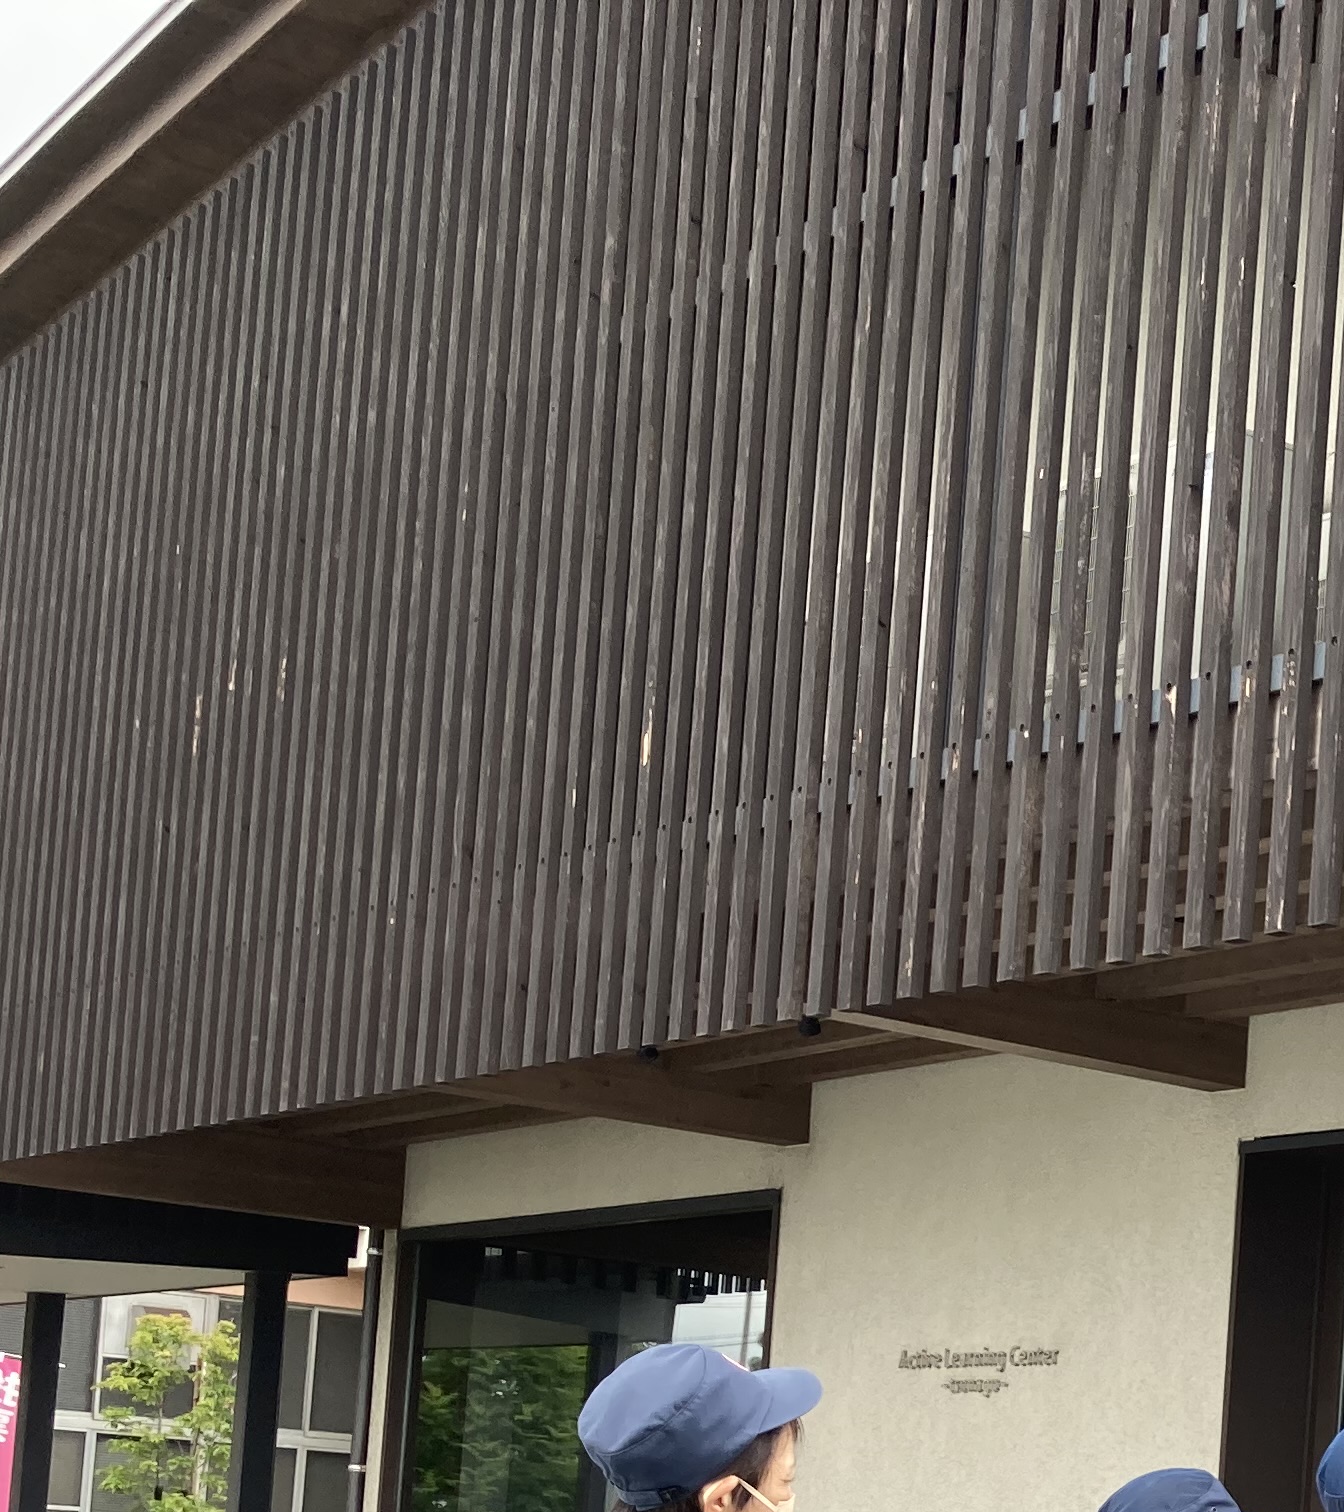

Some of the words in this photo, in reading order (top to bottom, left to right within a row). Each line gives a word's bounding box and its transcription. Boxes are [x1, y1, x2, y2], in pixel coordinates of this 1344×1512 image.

[898, 1349, 942, 1369] Active
[944, 1347, 1007, 1372] Learning
[1009, 1345, 1060, 1366] Center
